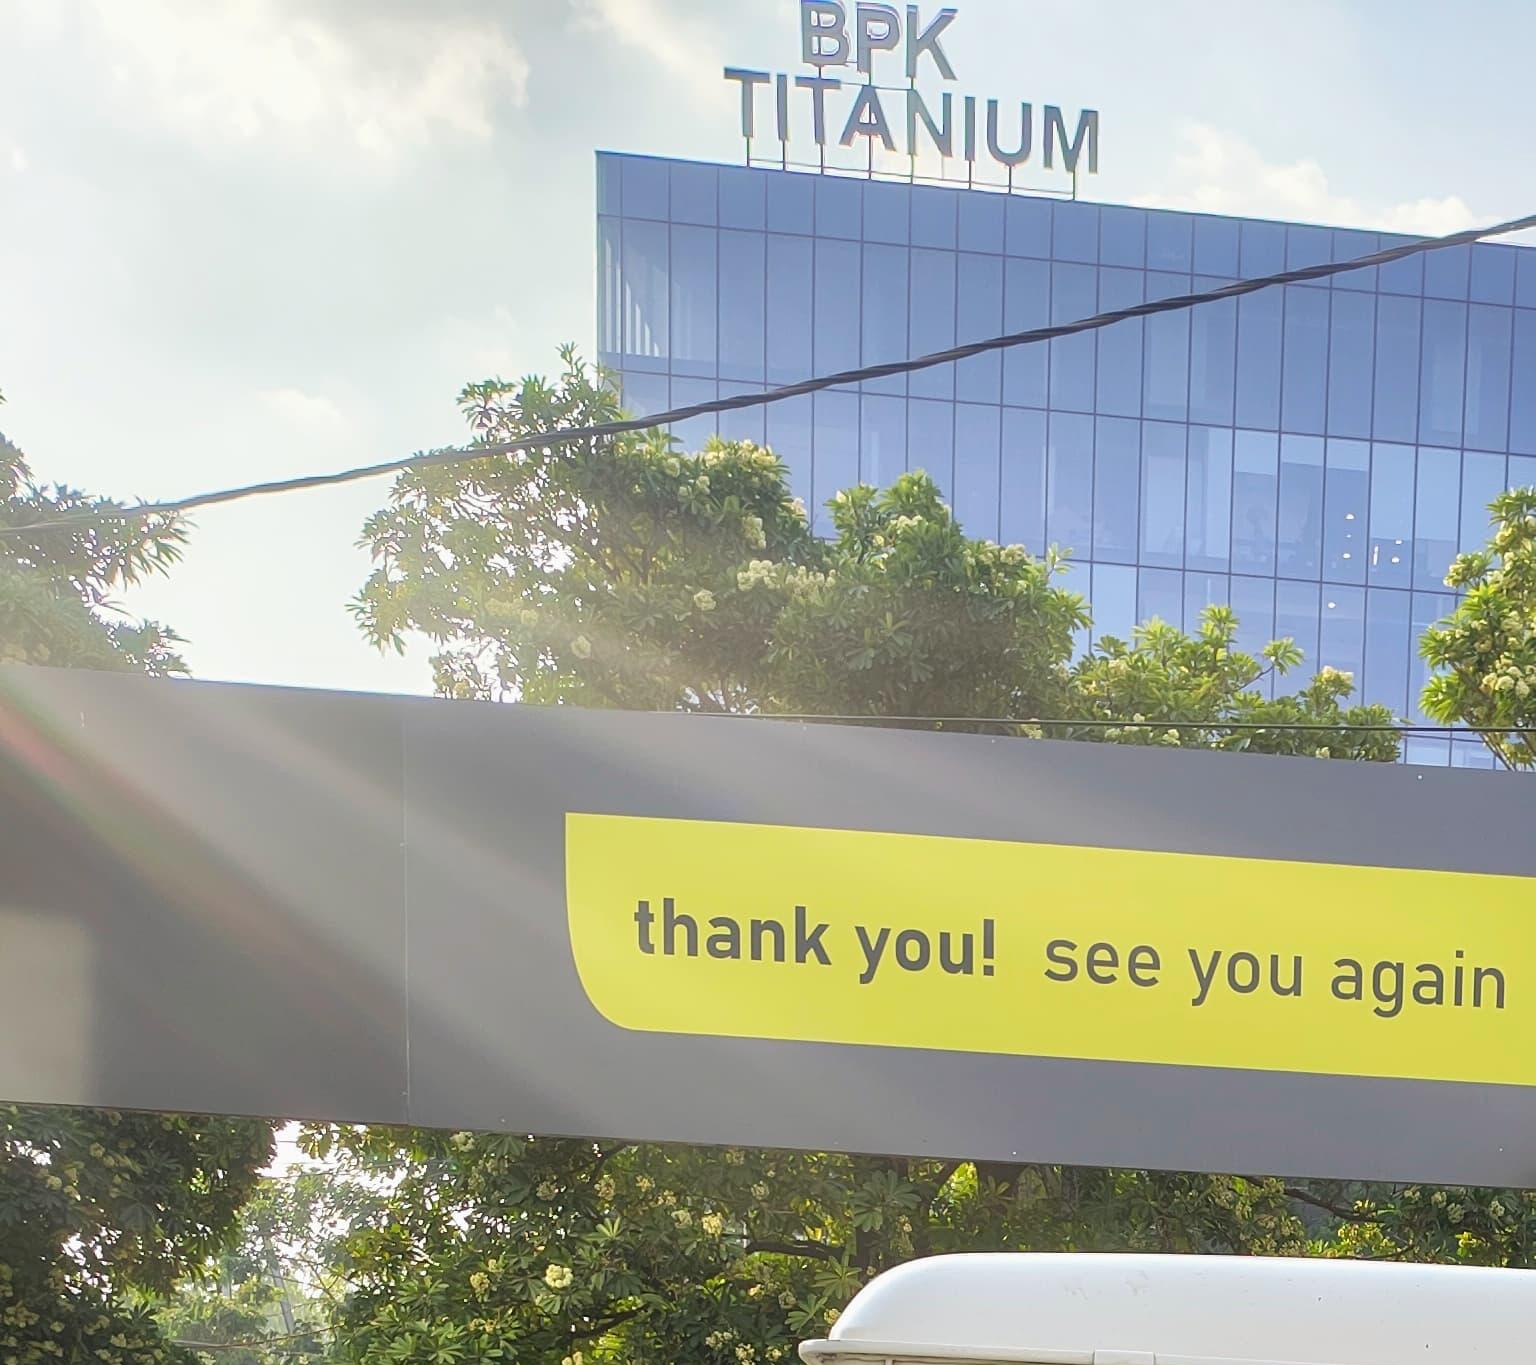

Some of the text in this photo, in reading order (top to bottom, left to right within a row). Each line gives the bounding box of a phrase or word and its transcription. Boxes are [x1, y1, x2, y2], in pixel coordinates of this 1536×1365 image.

[800, 0, 958, 81] BPK
[723, 66, 1099, 174] TITANIUM
[633, 897, 1506, 1018] thank you! see you again
